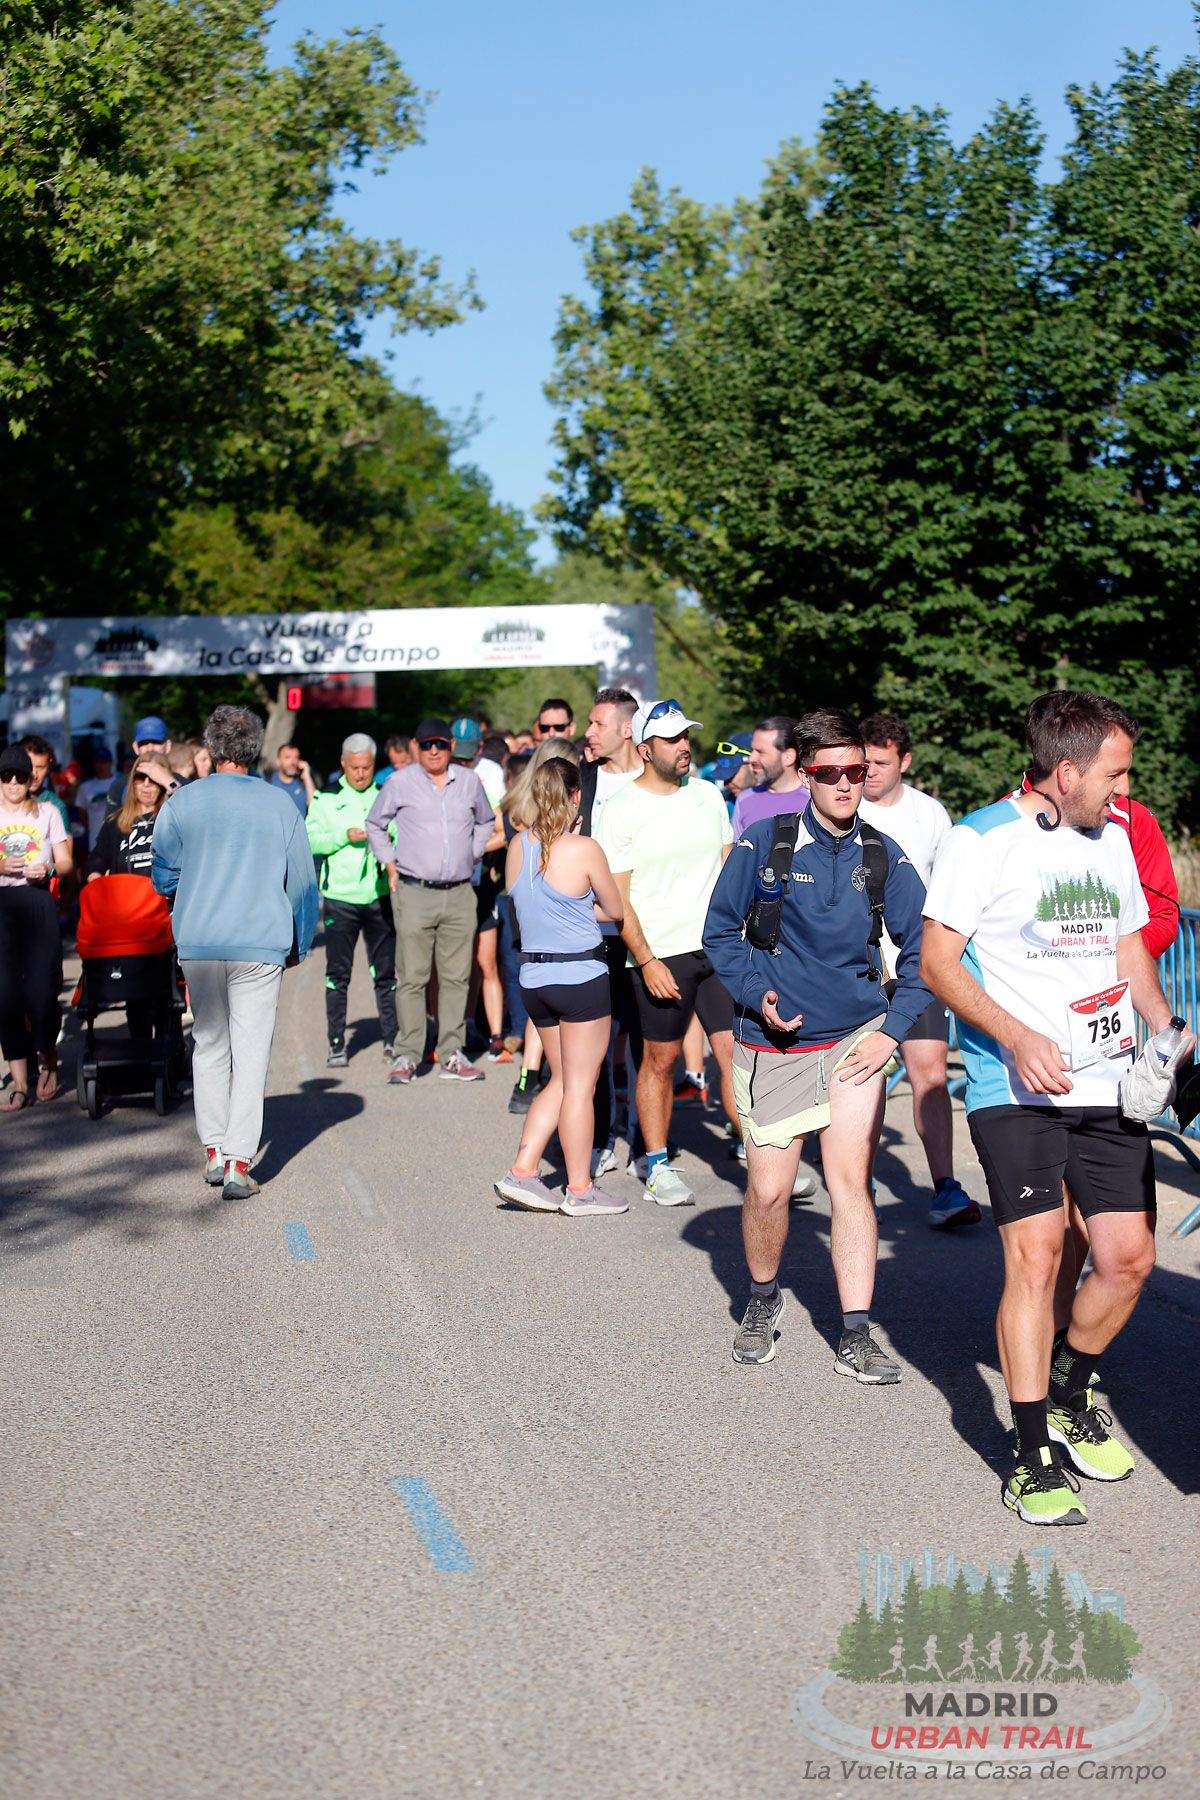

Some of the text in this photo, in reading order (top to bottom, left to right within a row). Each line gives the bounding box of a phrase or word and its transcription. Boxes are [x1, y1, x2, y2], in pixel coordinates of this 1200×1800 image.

[263, 619, 373, 638] Vuelta a
[199, 644, 440, 667] la Casa de Campo
[1051, 937, 1085, 947] URBAN
[1027, 951, 1038, 959] La
[1041, 950, 1070, 959] Vuelta
[1082, 949, 1101, 958] Casa
[1088, 1011, 1121, 1043] 736
